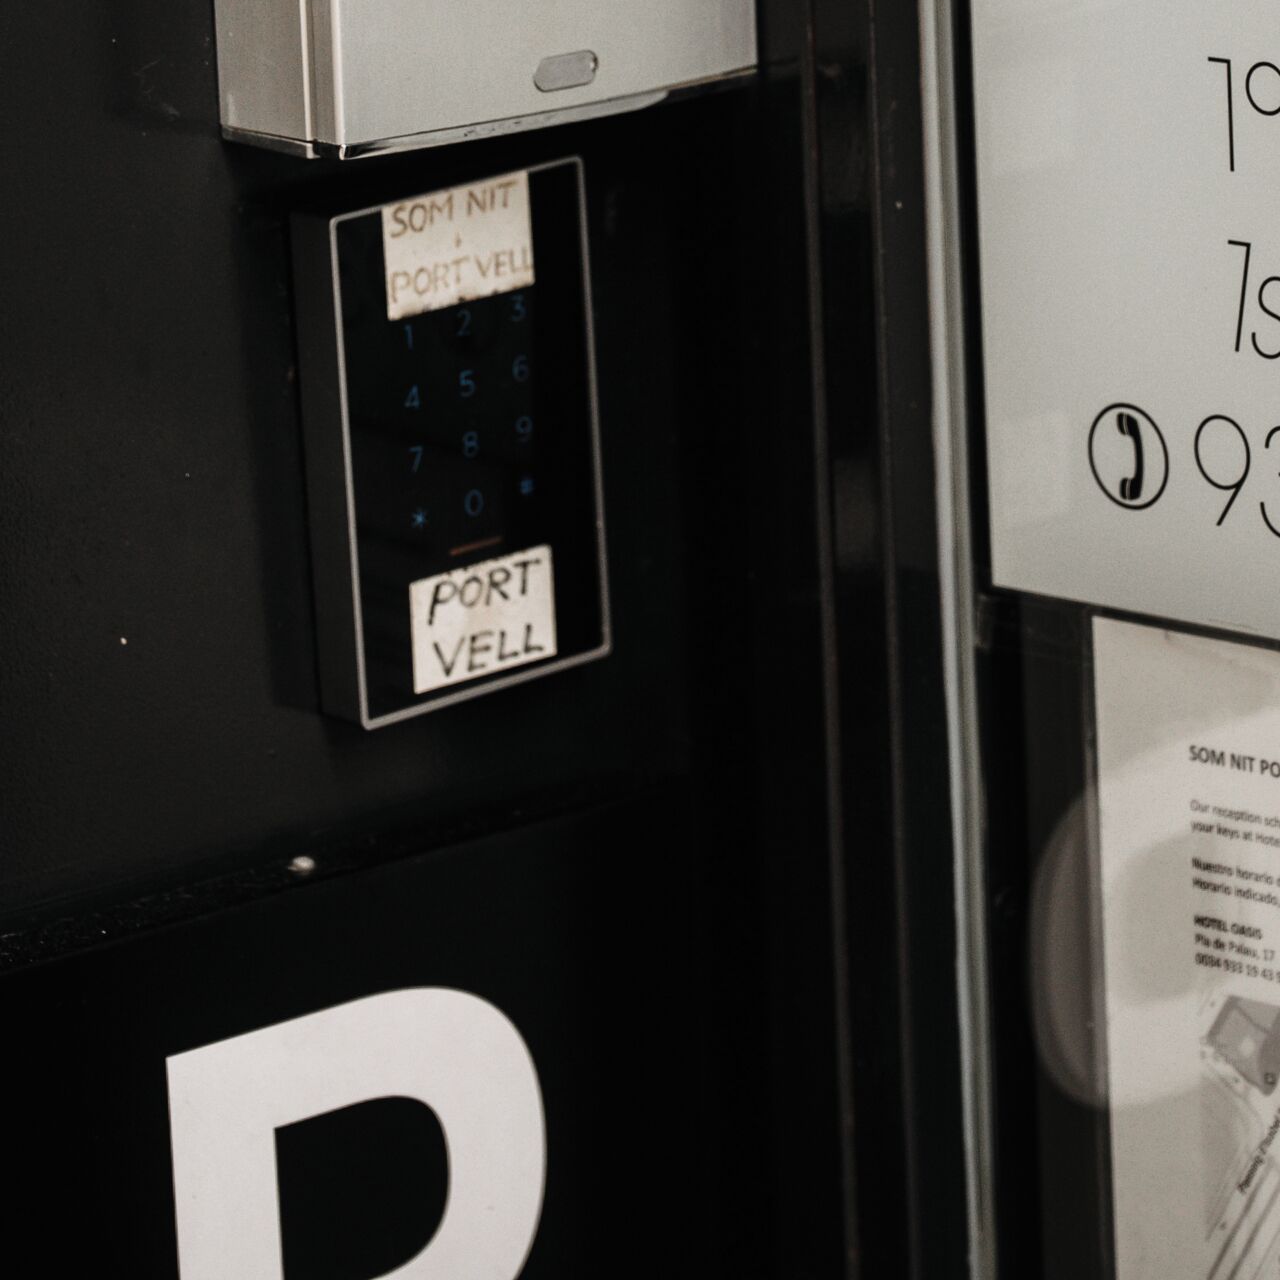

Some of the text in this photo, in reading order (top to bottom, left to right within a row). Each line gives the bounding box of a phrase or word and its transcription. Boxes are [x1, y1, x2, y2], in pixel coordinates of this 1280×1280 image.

[389, 180, 516, 239] SOM NIT
[391, 246, 534, 304] PORT VELL
[457, 311, 471, 336] 2
[405, 357, 528, 409] 4 5 6
[410, 417, 532, 472] 7 8 9
[428, 557, 542, 625] PORT
[432, 625, 544, 677] VELL
[1189, 745, 1225, 767] SOM
[1230, 752, 1255, 772] NIT
[1190, 799, 1210, 814] Our
[1213, 805, 1263, 825] reception
[1242, 831, 1253, 841] at
